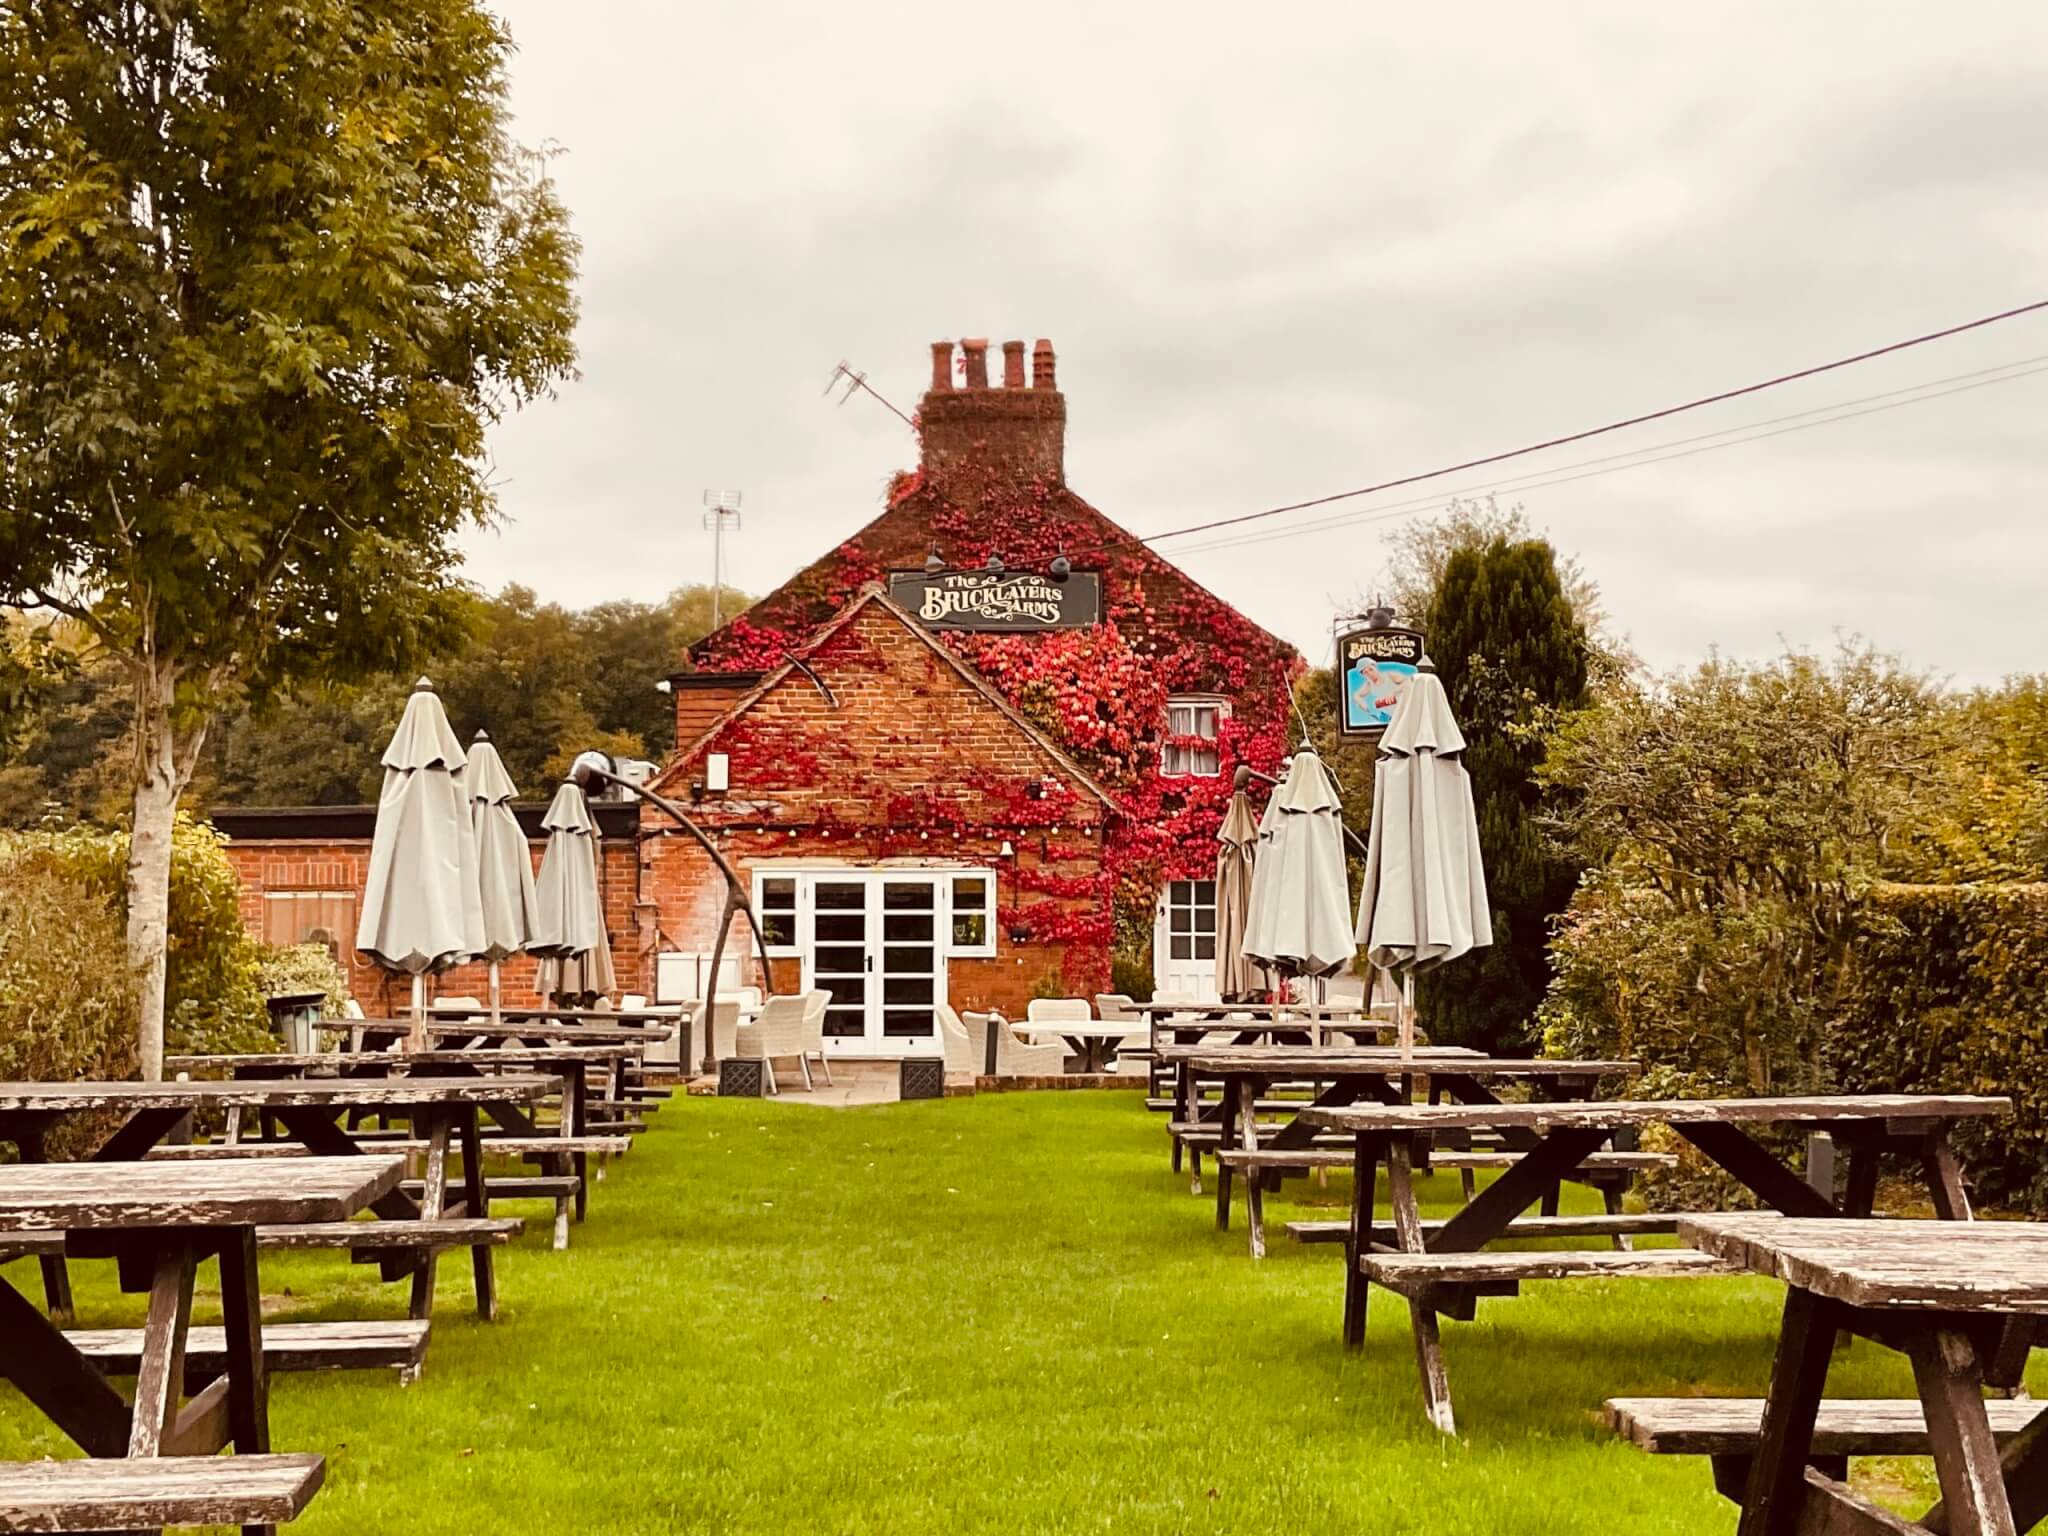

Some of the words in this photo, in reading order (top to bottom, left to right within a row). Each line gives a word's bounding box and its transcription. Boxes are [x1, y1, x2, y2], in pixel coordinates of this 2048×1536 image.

[945, 576, 978, 588] The
[920, 586, 1063, 620] BRICKLAYERS
[1008, 600, 1061, 623] ARMS
